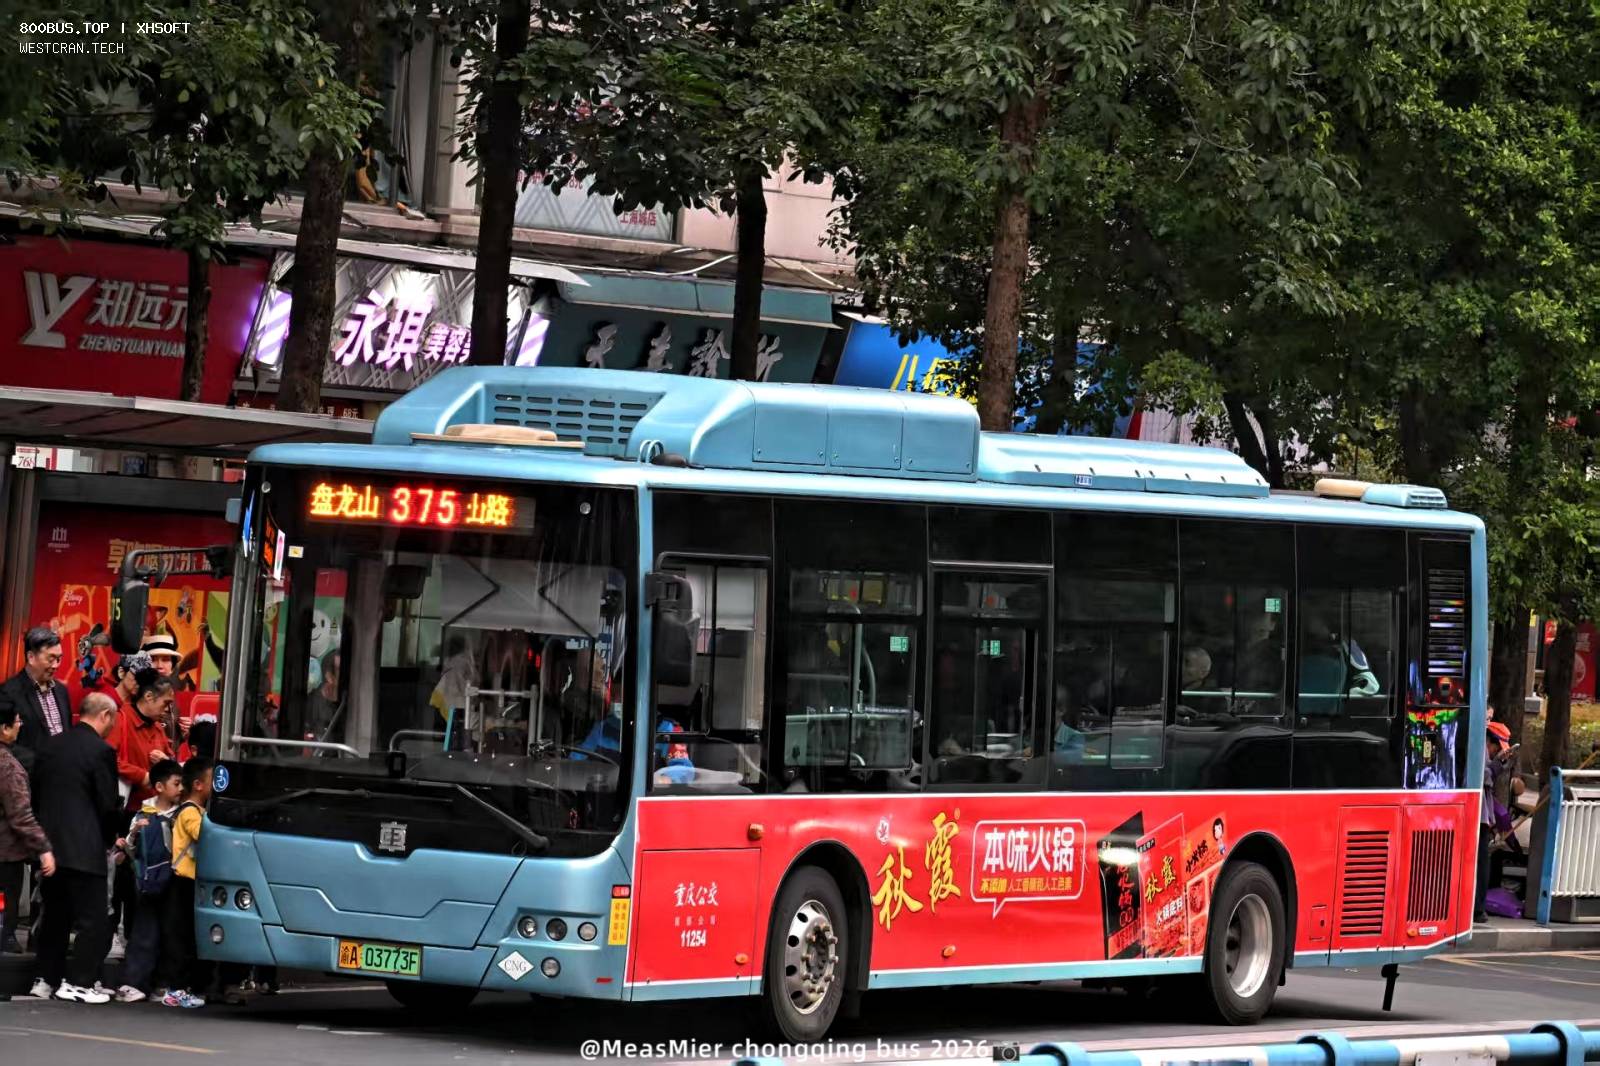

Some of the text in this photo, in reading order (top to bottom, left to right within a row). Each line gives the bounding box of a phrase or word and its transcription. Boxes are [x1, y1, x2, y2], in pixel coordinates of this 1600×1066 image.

[332, 289, 433, 372] 永琪
[310, 482, 379, 518] 盘龙山
[391, 486, 457, 525] 375
[982, 826, 1075, 874] 本味火锅
[674, 881, 719, 907] 重庆公交
[680, 930, 707, 948] 11254
[340, 945, 419, 971] 渝A 03773F
[504, 957, 527, 973] CNG
